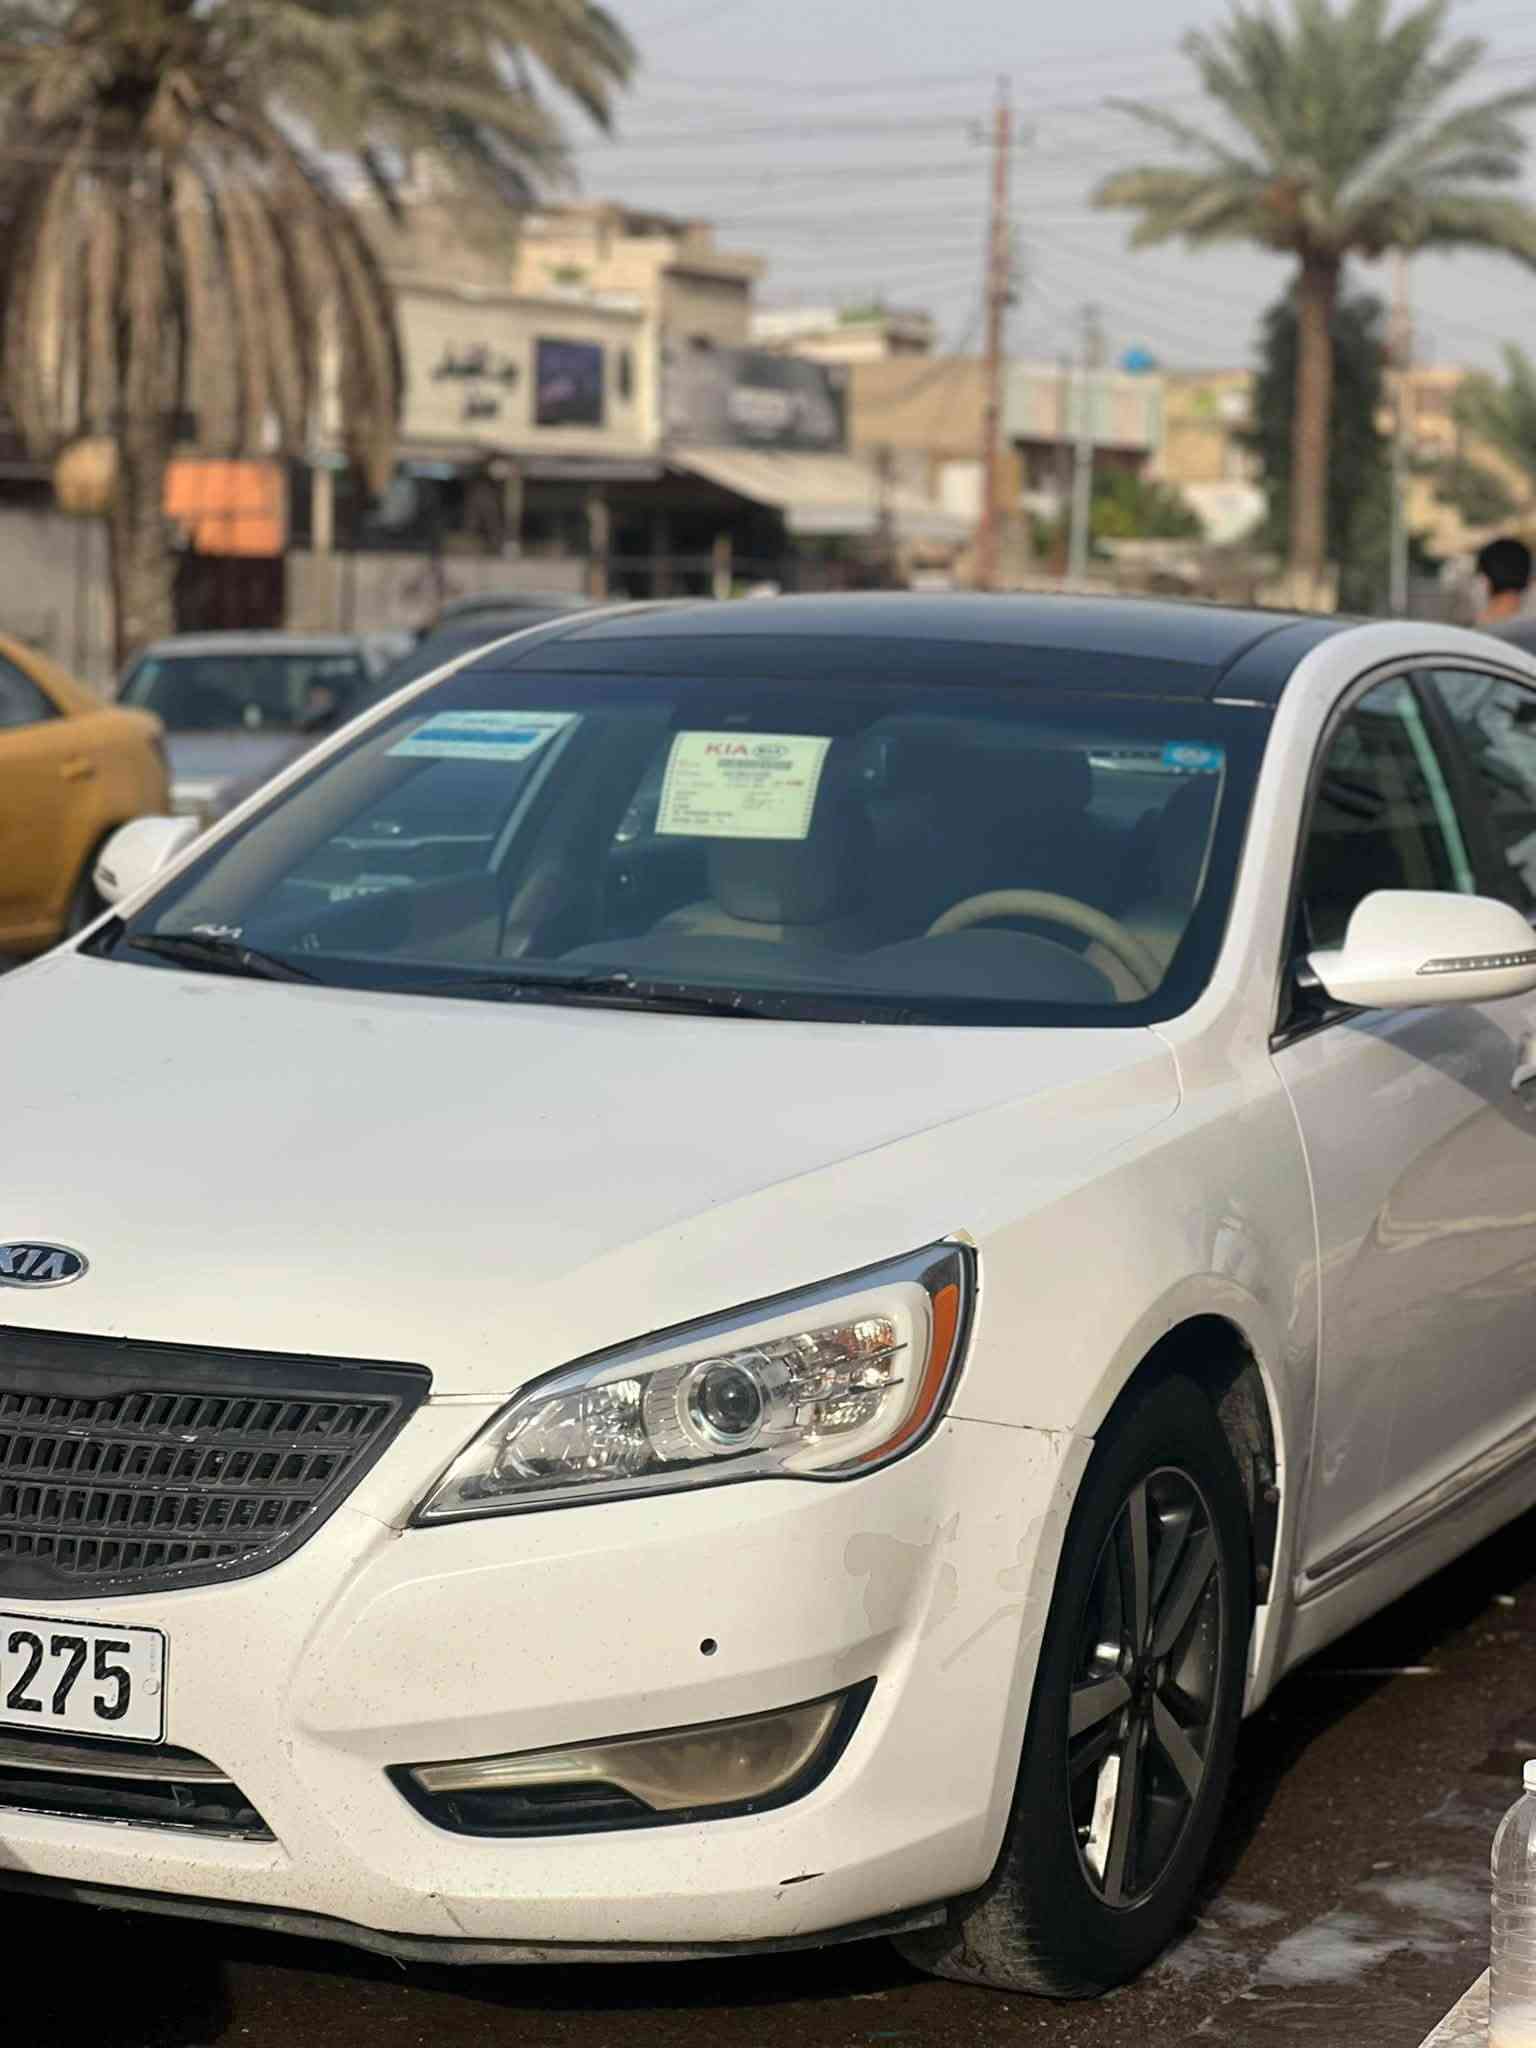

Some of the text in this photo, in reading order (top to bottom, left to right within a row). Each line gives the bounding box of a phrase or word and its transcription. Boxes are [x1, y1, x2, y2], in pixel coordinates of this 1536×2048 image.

[704, 742, 747, 755] KIA
[0, 1247, 67, 1279] KIA
[6, 1630, 131, 1721] 275
